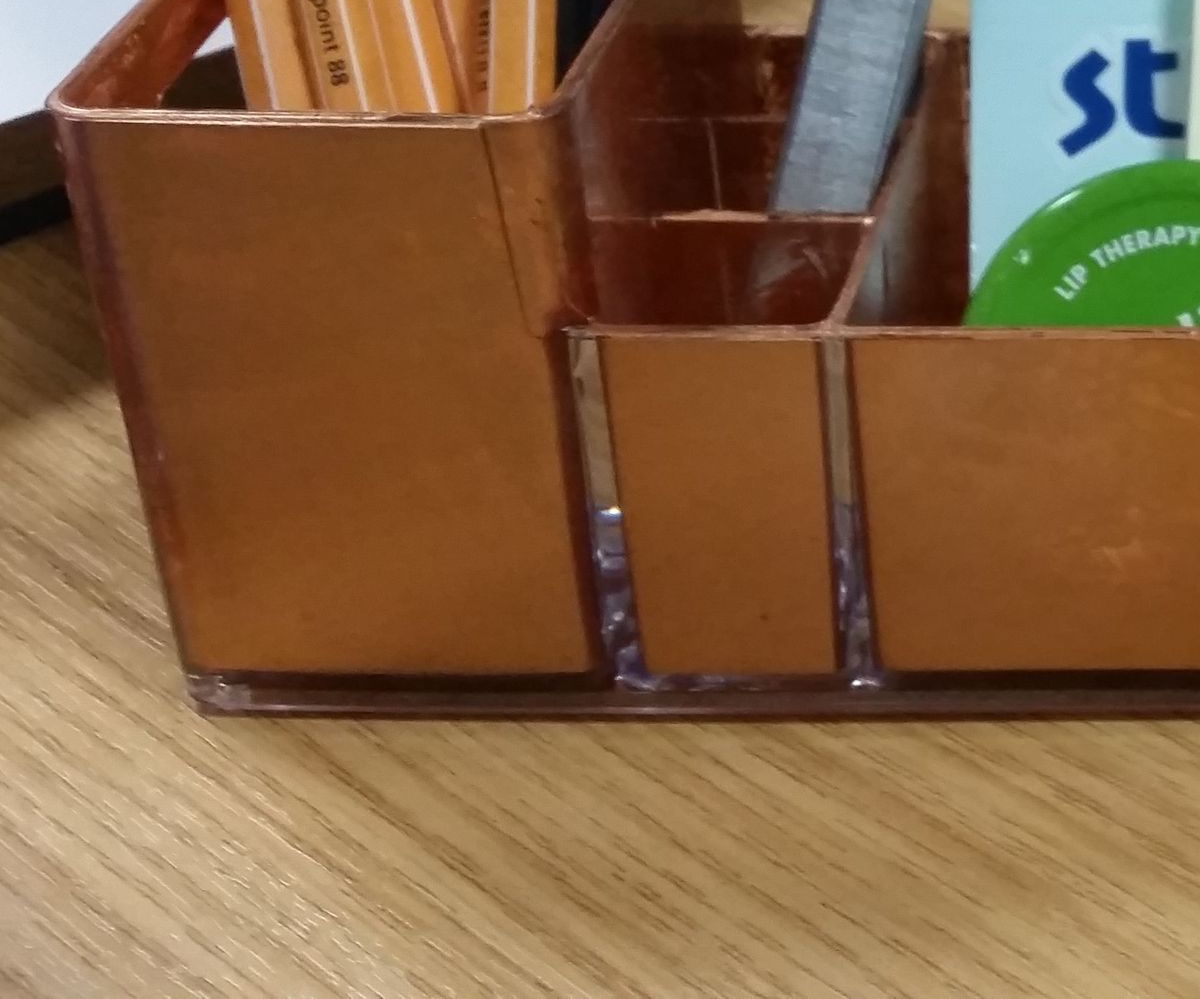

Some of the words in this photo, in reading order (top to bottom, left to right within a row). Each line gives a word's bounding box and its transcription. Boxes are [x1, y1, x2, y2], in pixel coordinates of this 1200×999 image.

[326, 59, 349, 87] 88
[1058, 39, 1186, 157] st
[1054, 264, 1088, 300] LIP
